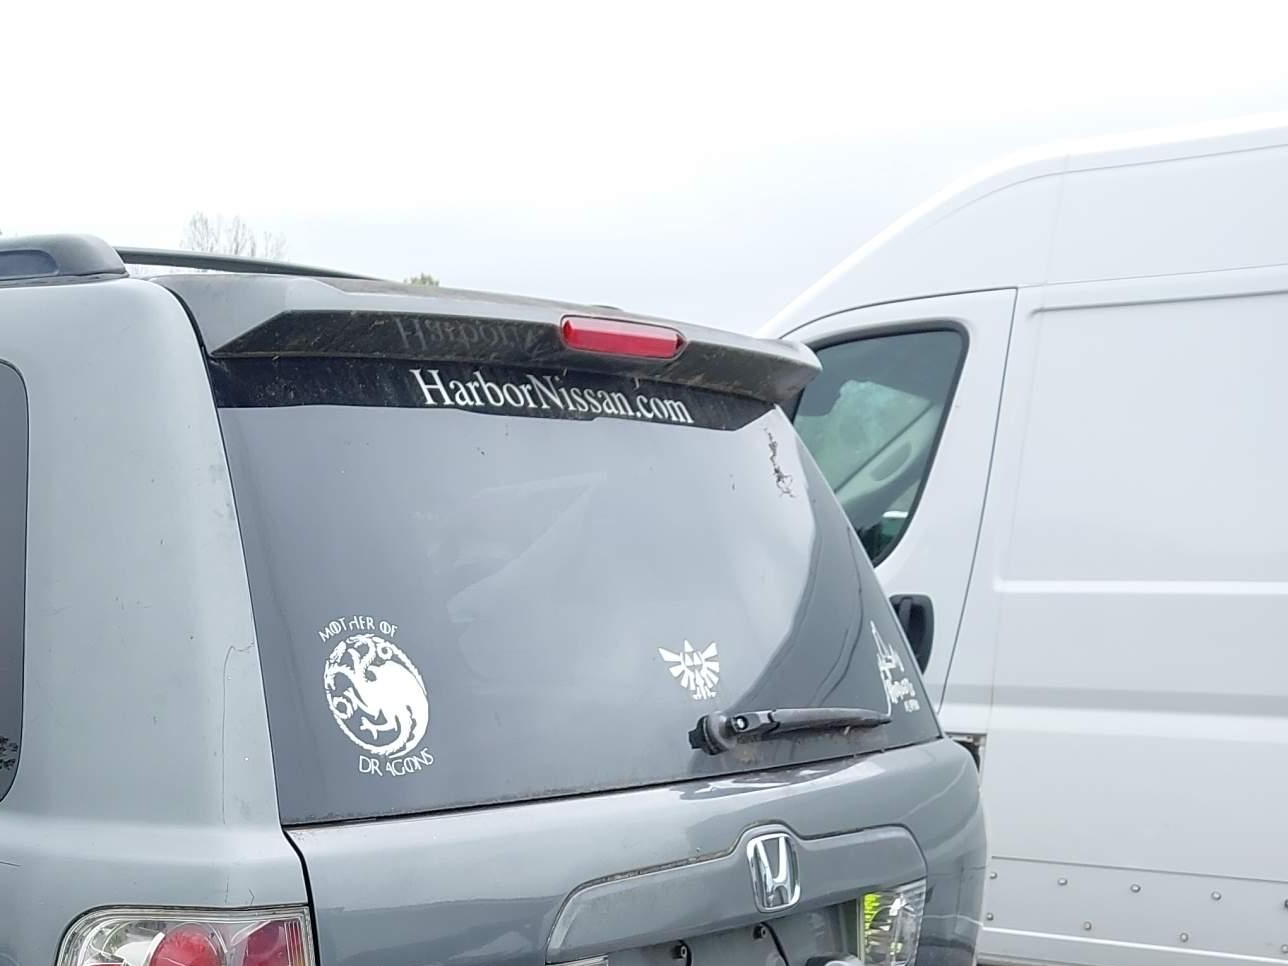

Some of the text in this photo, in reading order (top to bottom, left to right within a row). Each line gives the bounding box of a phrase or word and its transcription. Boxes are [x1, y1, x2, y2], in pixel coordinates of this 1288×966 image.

[411, 368, 694, 423] HarborNissan.com
[319, 616, 398, 642] MOTHER OF
[359, 748, 434, 776] DRAGONS
